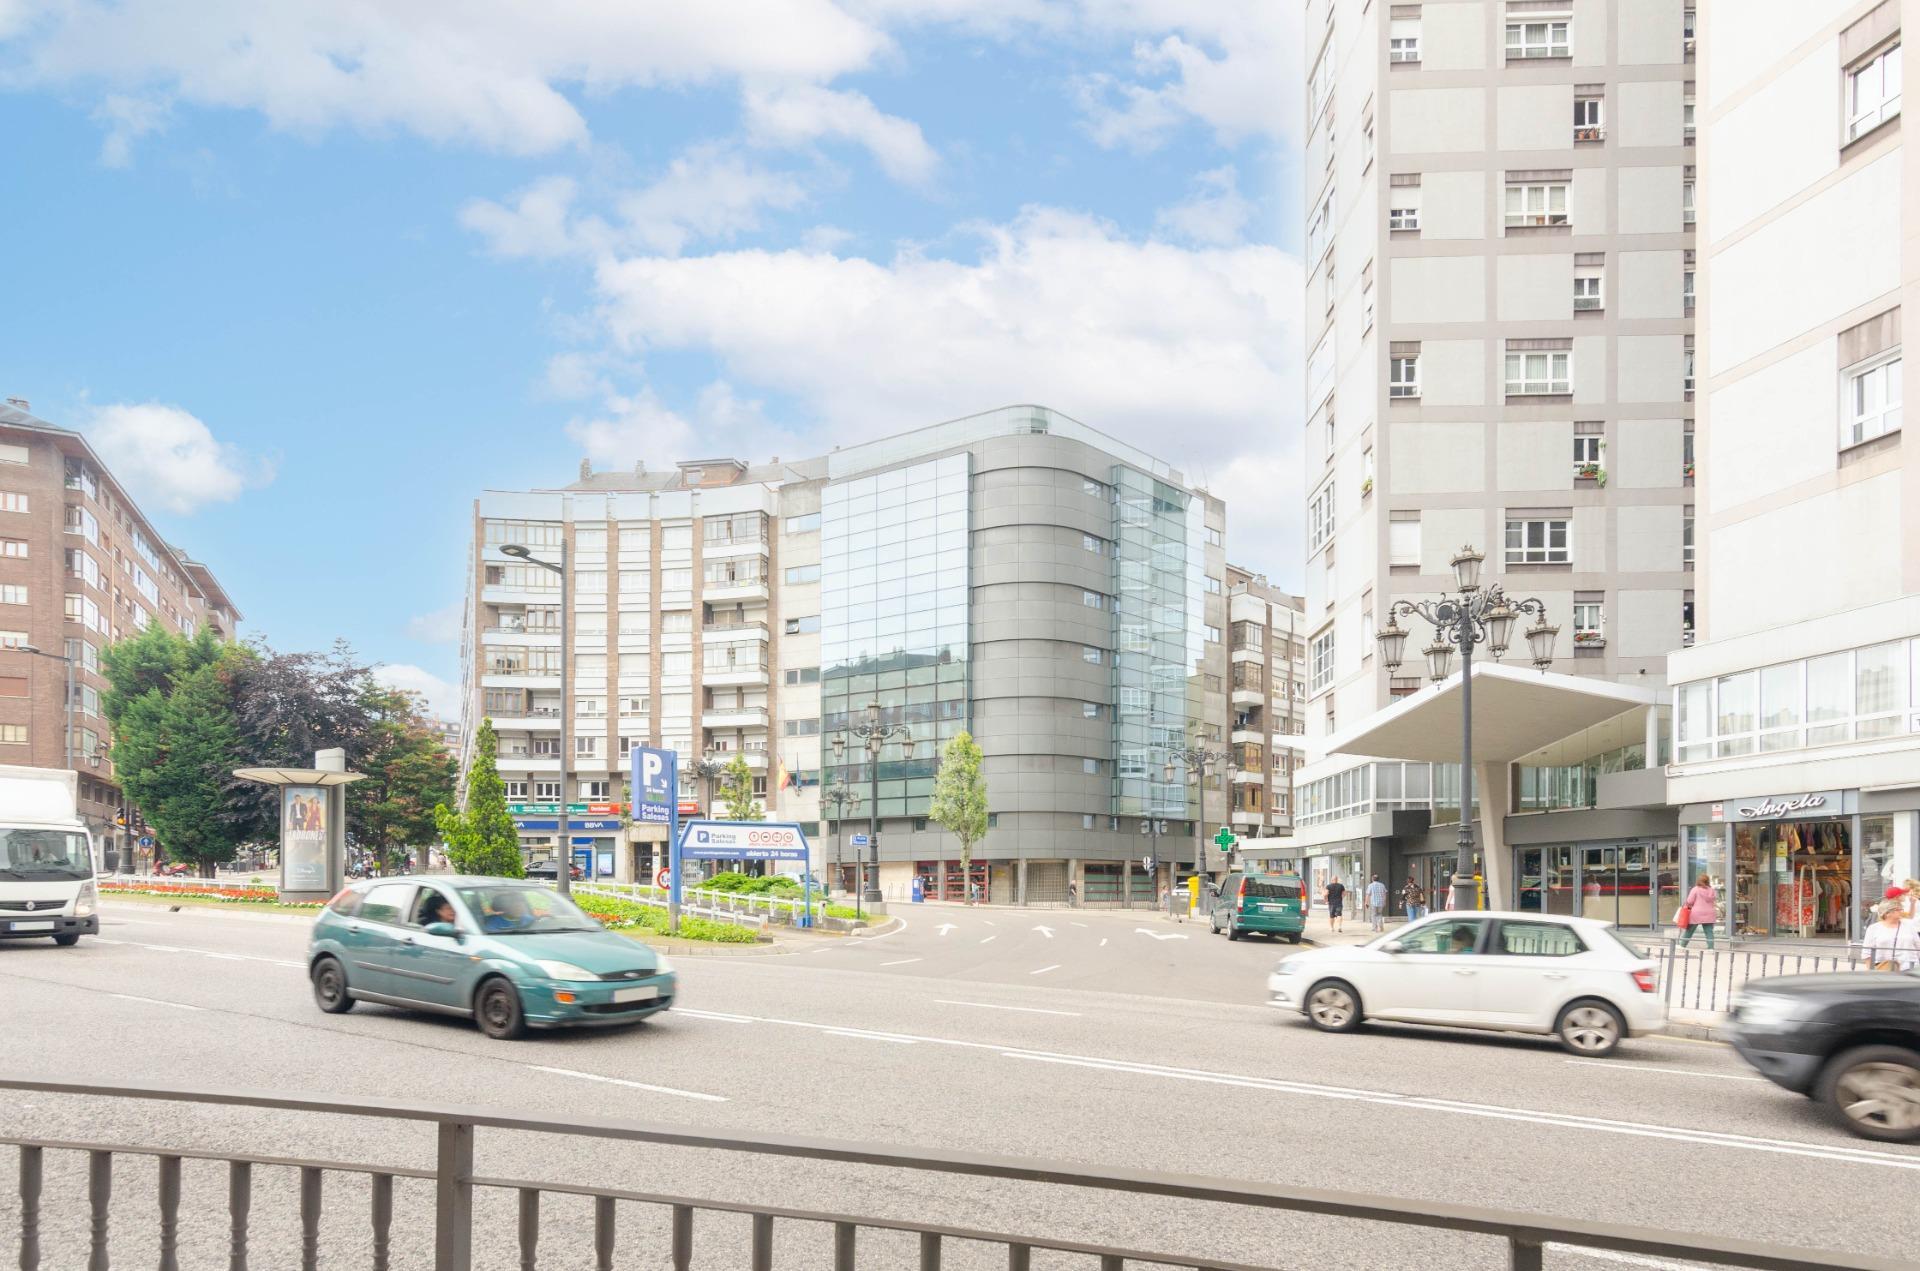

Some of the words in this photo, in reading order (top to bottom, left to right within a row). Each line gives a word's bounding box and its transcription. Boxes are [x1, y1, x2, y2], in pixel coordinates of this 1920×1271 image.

[642, 752, 662, 786] P
[641, 804, 669, 815] Parking
[1738, 793, 1825, 818] Angela
[642, 812, 669, 821] Salesas
[711, 832, 736, 840] Parking
